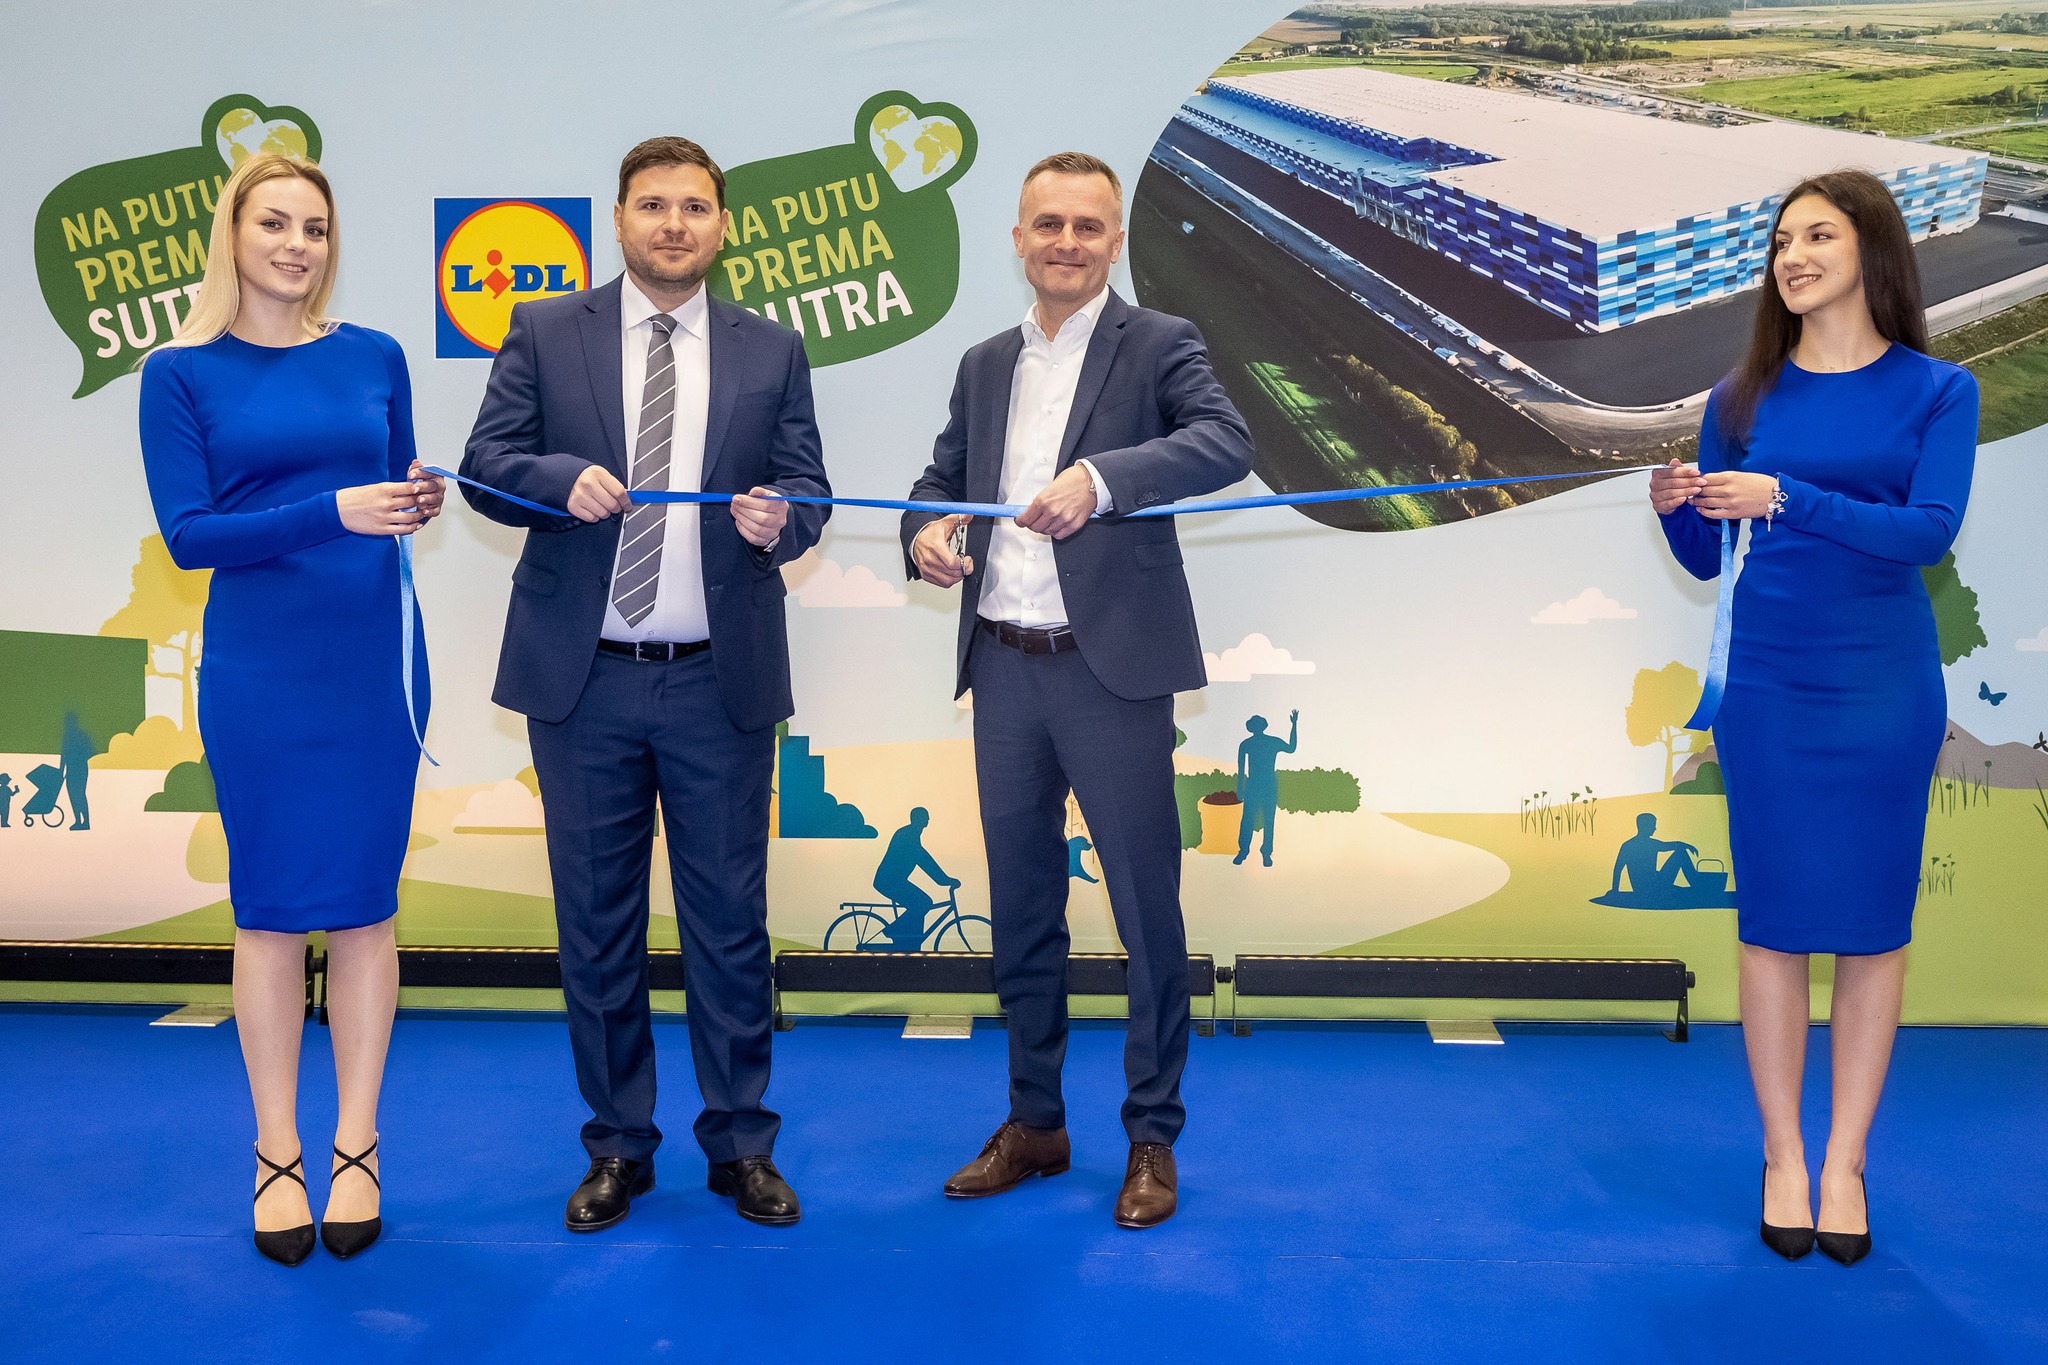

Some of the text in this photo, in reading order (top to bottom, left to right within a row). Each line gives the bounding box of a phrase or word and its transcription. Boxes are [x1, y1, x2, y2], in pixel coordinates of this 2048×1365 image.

[61, 175, 224, 252] NA PUTU
[771, 172, 880, 234] PUTU
[75, 229, 208, 302] PREM
[722, 219, 894, 301] PREMA
[88, 281, 204, 359] SUT
[744, 270, 914, 339] UTRA
